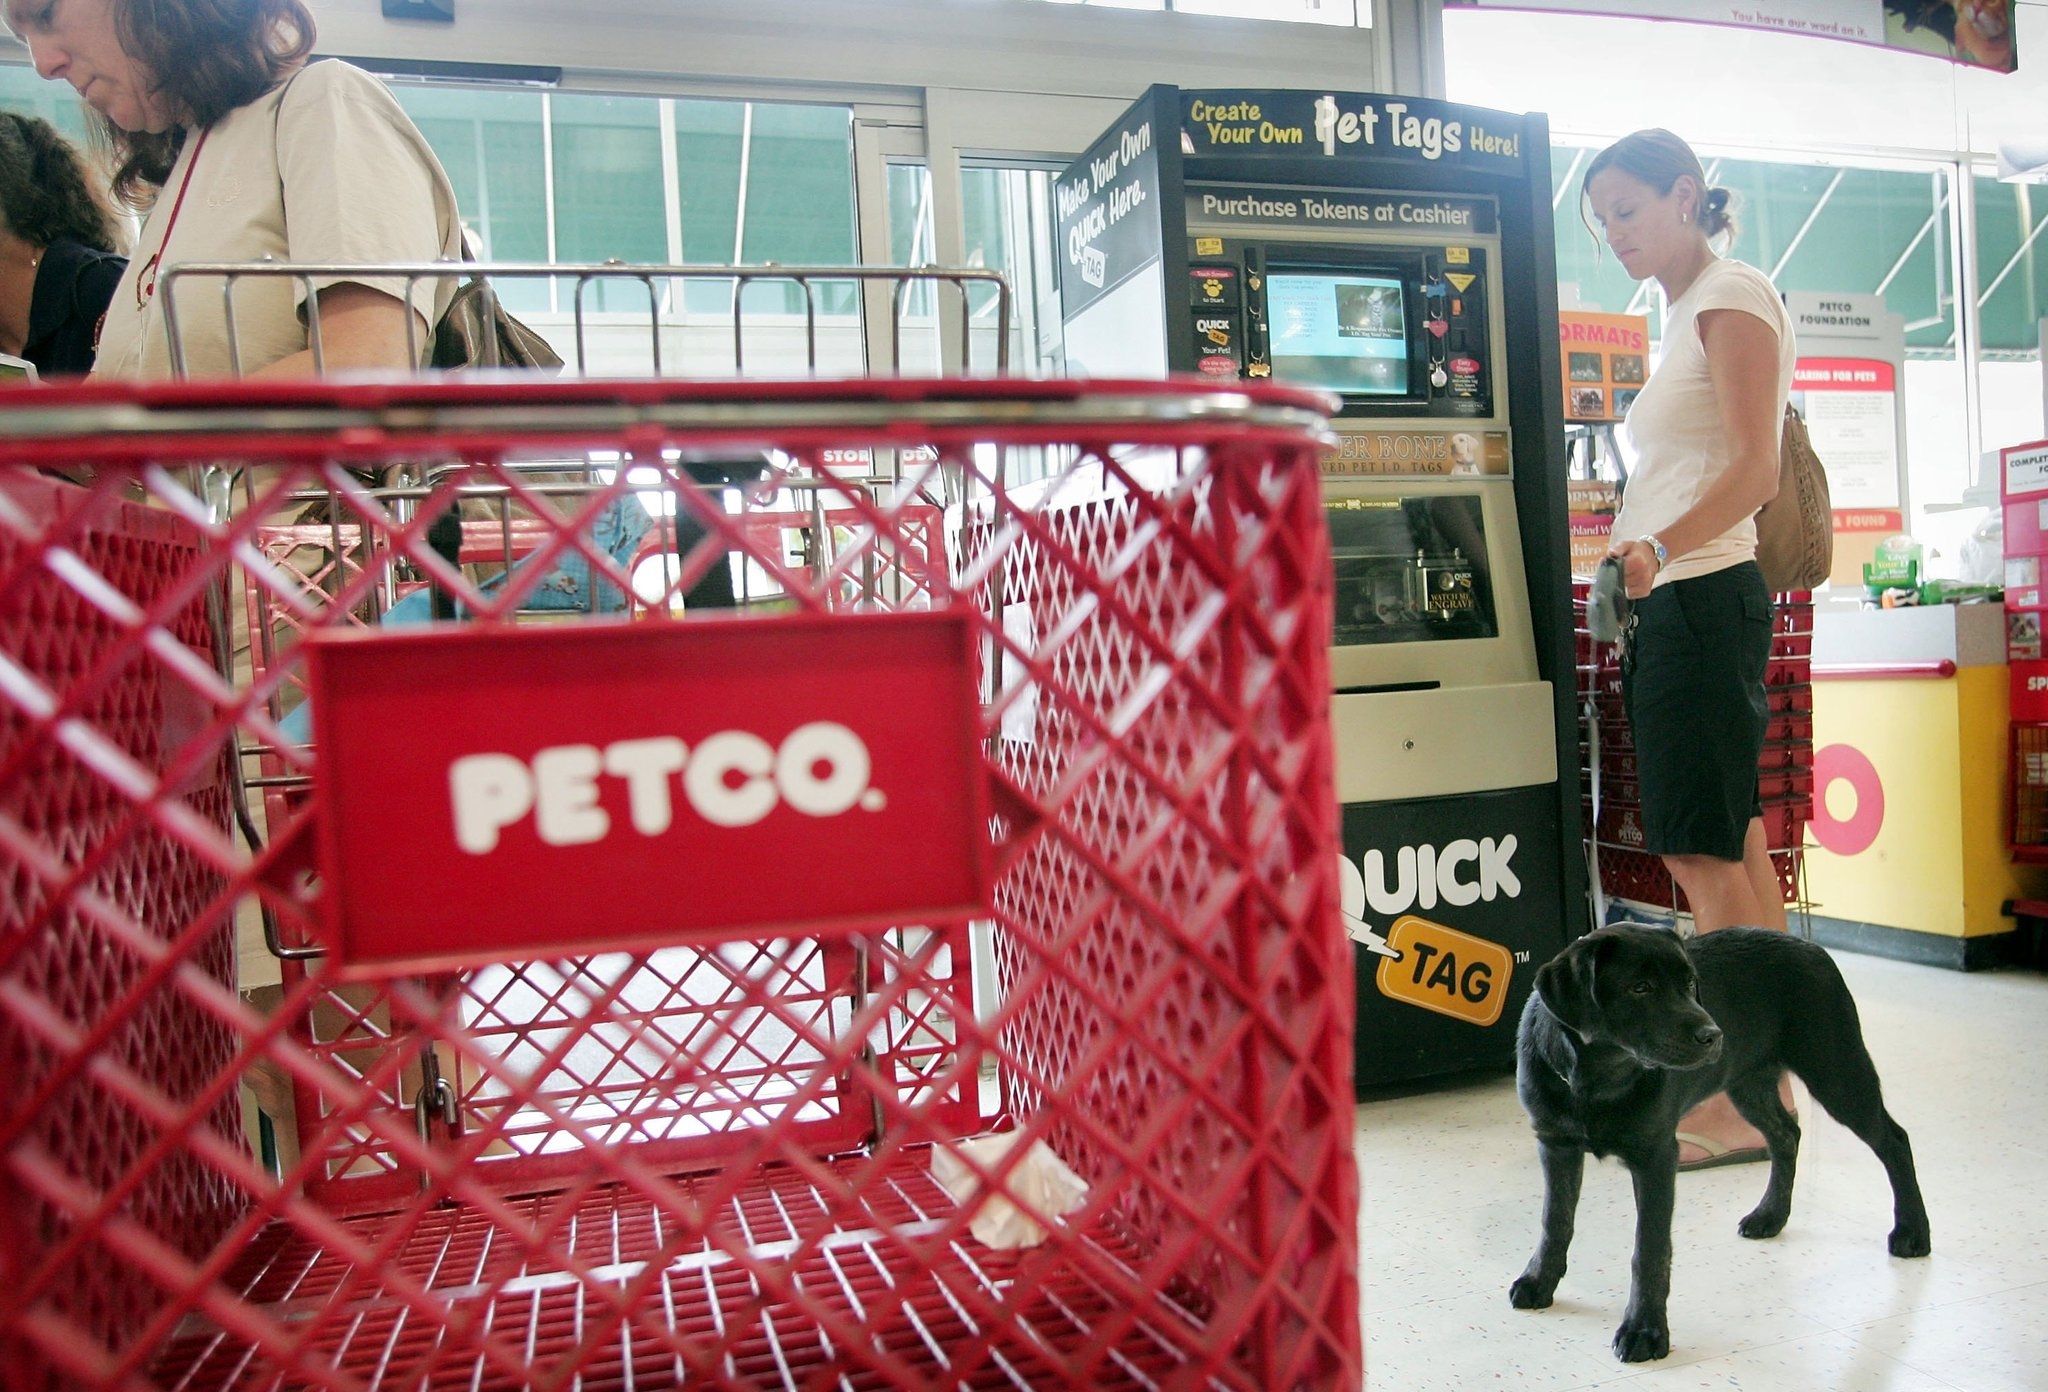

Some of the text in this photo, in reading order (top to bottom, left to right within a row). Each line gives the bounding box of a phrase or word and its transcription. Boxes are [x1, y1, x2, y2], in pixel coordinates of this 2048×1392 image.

[1731, 10, 1752, 22] You
[1756, 11, 1785, 26] have
[1788, 19, 1806, 28] our
[1810, 22, 1838, 33] word
[1857, 25, 1868, 37] it.
[1191, 99, 1262, 122] Create
[1207, 121, 1303, 144] Your Own
[1314, 97, 1519, 160] Pet Tags Here!
[1059, 122, 1150, 222] Make Your Own
[1203, 194, 1470, 225] Purchase Tokens at Cashier
[1069, 179, 1146, 265] QUICK Here.
[1086, 256, 1102, 278] TAG
[1819, 302, 1852, 312] PETCO
[1196, 319, 1230, 332] QUICK
[1799, 315, 1871, 327] FOUNDATION
[1202, 346, 1217, 354] Your
[1833, 370, 1853, 381] FOR
[1854, 370, 1877, 381] PETS
[1377, 435, 1447, 460] BONE
[1353, 463, 1376, 472] PET
[1382, 462, 1405, 472] I.D.
[1411, 462, 1443, 473] TAGS
[1845, 515, 1887, 527] FOUND
[1429, 600, 1473, 610] ENGRAVE
[1431, 593, 1458, 601] WATCH
[1413, 942, 1492, 1003] TAG
